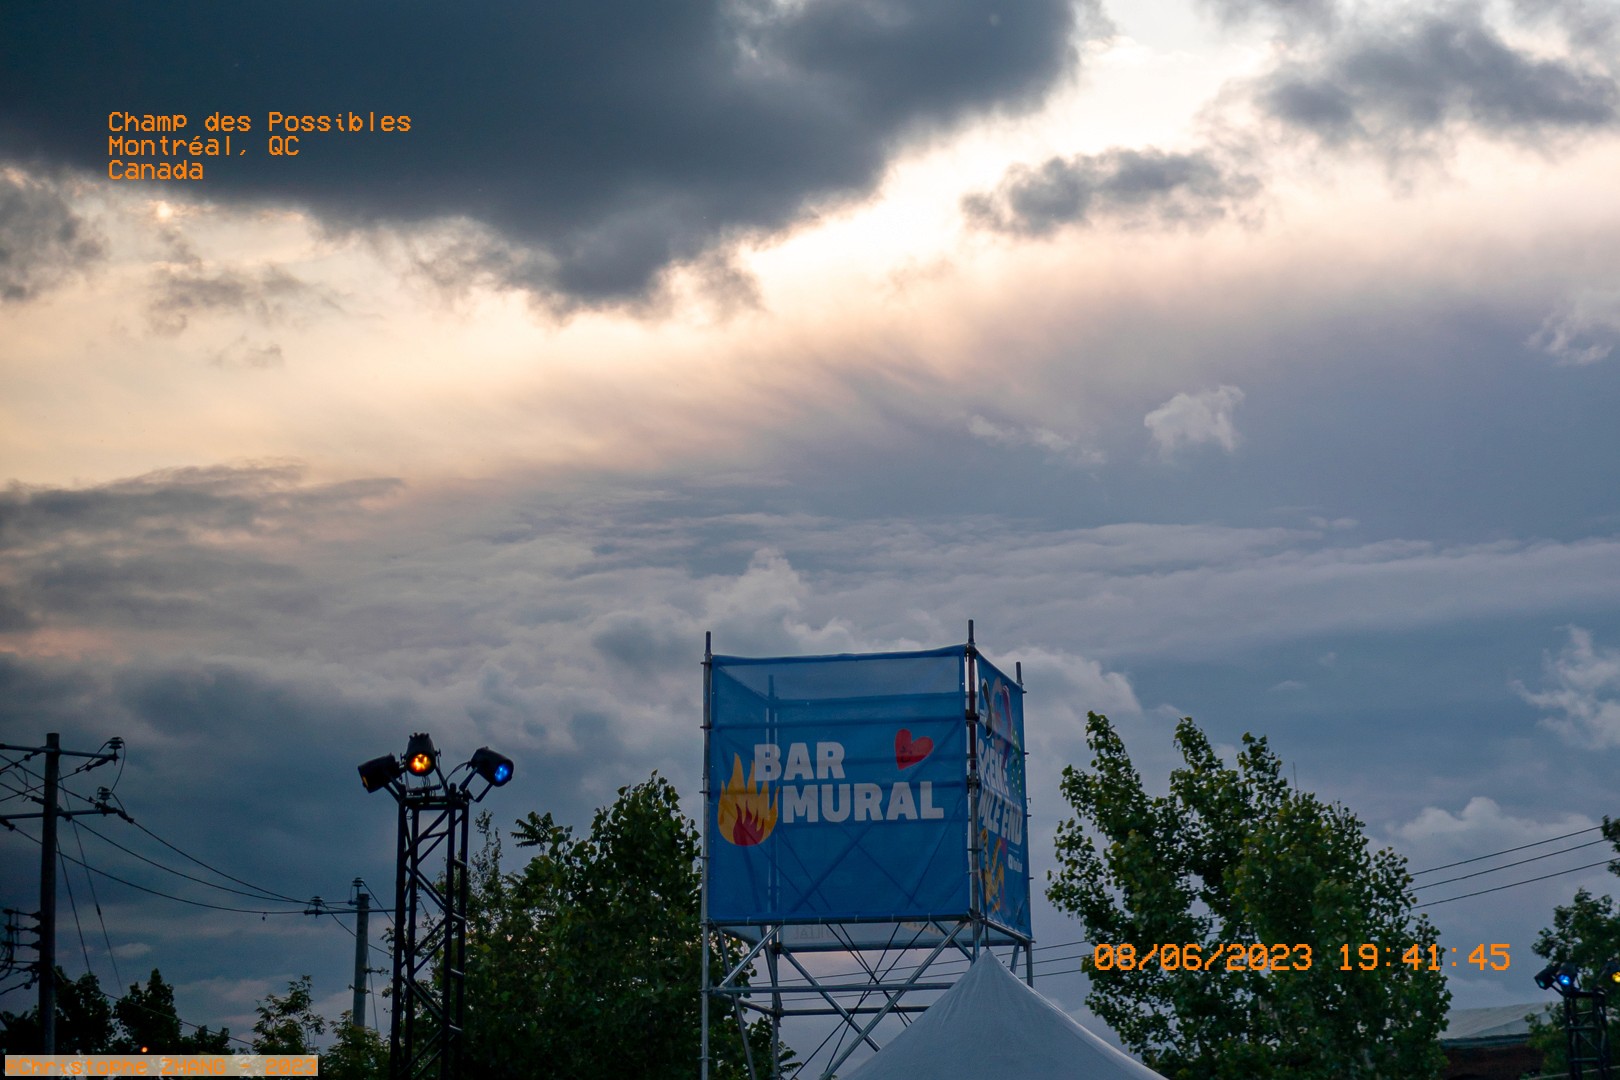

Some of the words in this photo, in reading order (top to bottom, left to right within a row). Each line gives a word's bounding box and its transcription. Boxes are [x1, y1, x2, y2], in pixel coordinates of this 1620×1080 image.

[754, 741, 846, 781] BAR
[782, 781, 945, 824] MURAL
[978, 783, 1002, 834] MILE
[1001, 795, 1023, 846] END
